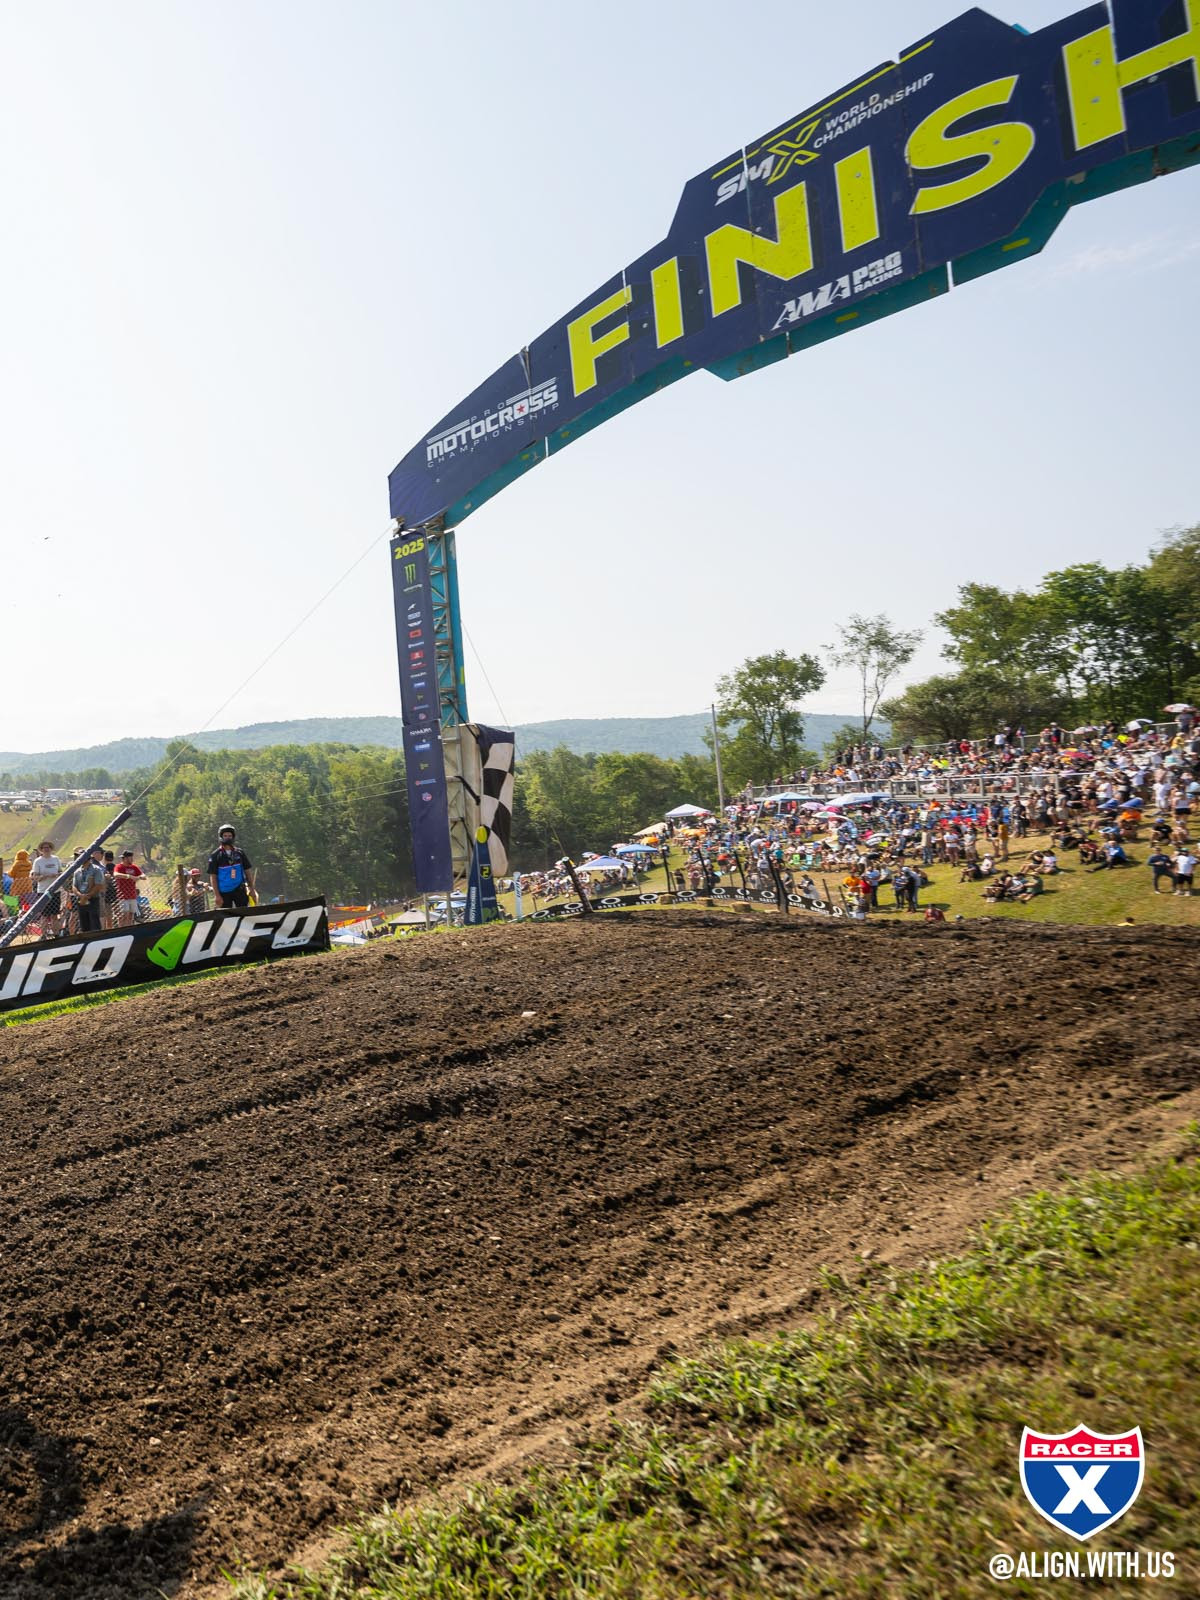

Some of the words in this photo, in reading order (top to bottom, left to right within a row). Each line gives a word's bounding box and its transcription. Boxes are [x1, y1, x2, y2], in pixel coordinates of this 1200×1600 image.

[813, 72, 935, 149] CHAMPIONSHIP
[825, 93, 880, 131] WORLD
[715, 117, 822, 206] SMX
[567, 0, 1200, 397] FINISH
[852, 251, 902, 286] PRO
[854, 266, 903, 294] RACING
[770, 274, 851, 331] AMA
[427, 385, 559, 461] MOTOCROSS
[427, 402, 560, 468] CHAMPIONSHIP
[470, 402, 505, 423] PRO
[394, 537, 424, 560] 2025
[182, 905, 324, 964] UFO
[274, 938, 308, 947] PLAST
[75, 971, 118, 982] PLAST
